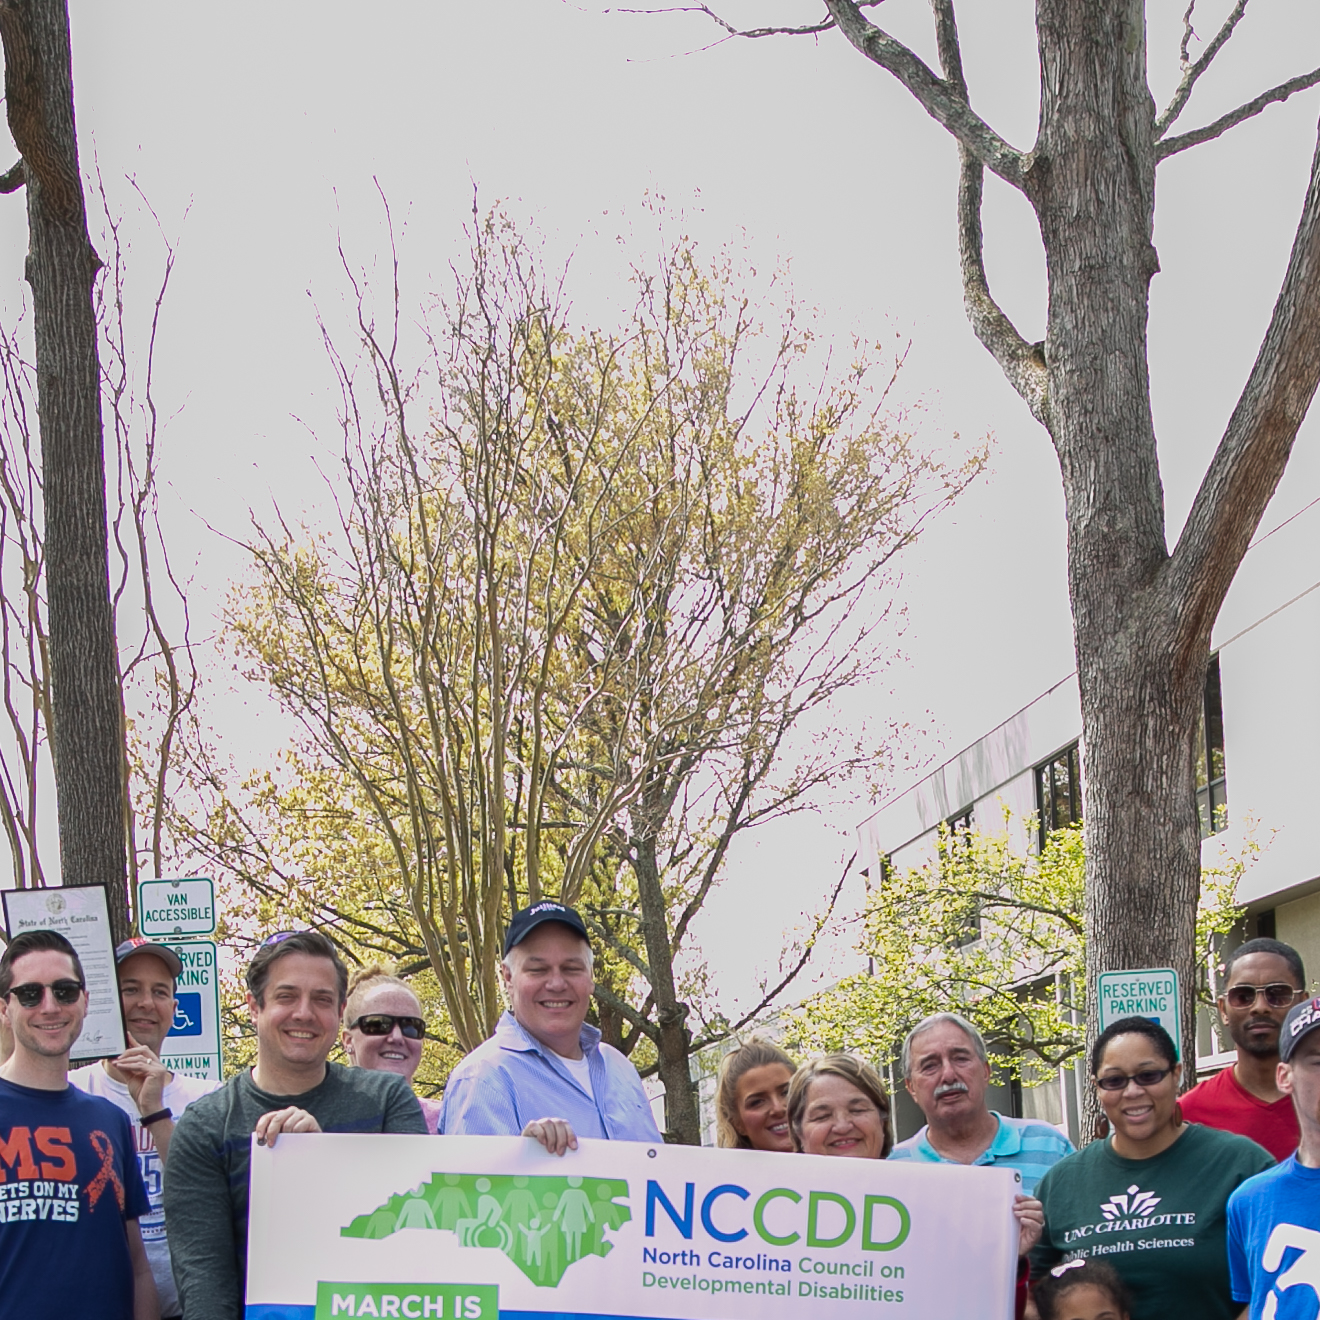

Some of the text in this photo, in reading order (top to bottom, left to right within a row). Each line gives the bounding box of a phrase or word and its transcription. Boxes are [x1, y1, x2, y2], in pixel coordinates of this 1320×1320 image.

[167, 893, 188, 906] VAN
[18, 914, 98, 929] State of North Carolina
[145, 907, 211, 922] ACCESSIBLE
[180, 951, 213, 968] RVED
[178, 969, 209, 986] KING
[1103, 981, 1173, 999] RESERVED
[1111, 997, 1167, 1015] PARKING
[162, 1056, 210, 1070] AXIMUM
[33, 1181, 55, 1197] ON
[58, 1182, 79, 1199] MY
[644, 1179, 911, 1252] NCCDD
[1064, 1213, 1196, 1244] UNC CHARLOTTE
[1092, 1241, 1135, 1257] Health
[1137, 1237, 1195, 1251] Sciences
[642, 1247, 905, 1279] North Carolina Council on
[642, 1272, 905, 1303] Developmental Disabilities
[331, 1294, 482, 1319] MARCH IS
